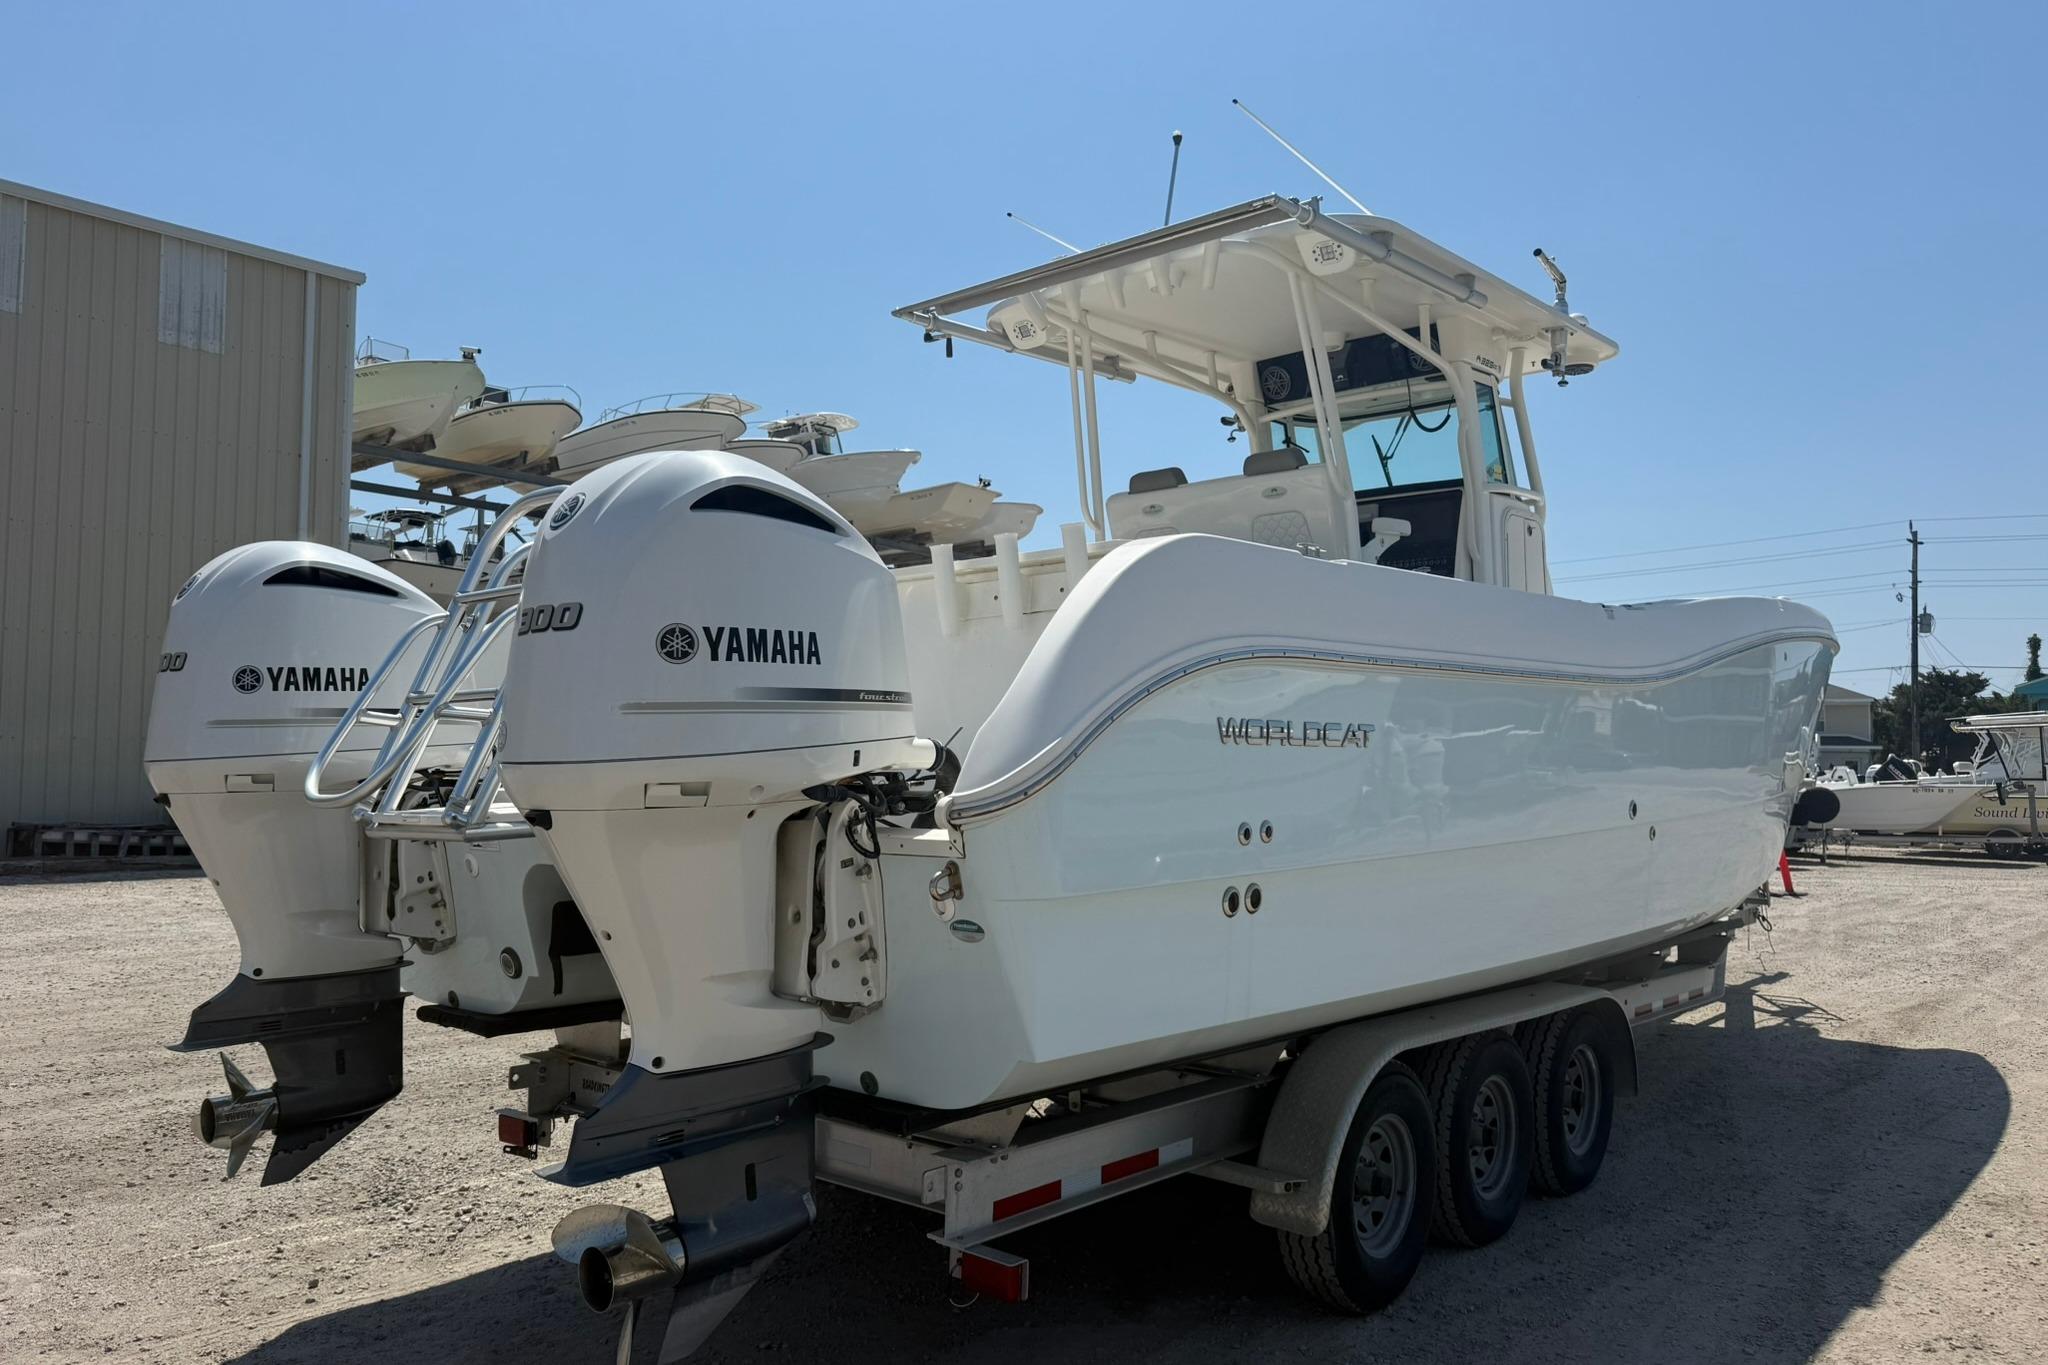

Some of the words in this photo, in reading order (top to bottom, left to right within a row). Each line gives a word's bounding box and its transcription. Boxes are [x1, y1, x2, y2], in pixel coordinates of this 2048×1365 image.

[702, 626, 822, 665] YAMAHA
[157, 652, 188, 673] 00
[266, 667, 370, 692] YAMAHA
[1217, 716, 1377, 749] WORLDCAT
[1974, 806, 2018, 819] Sound
